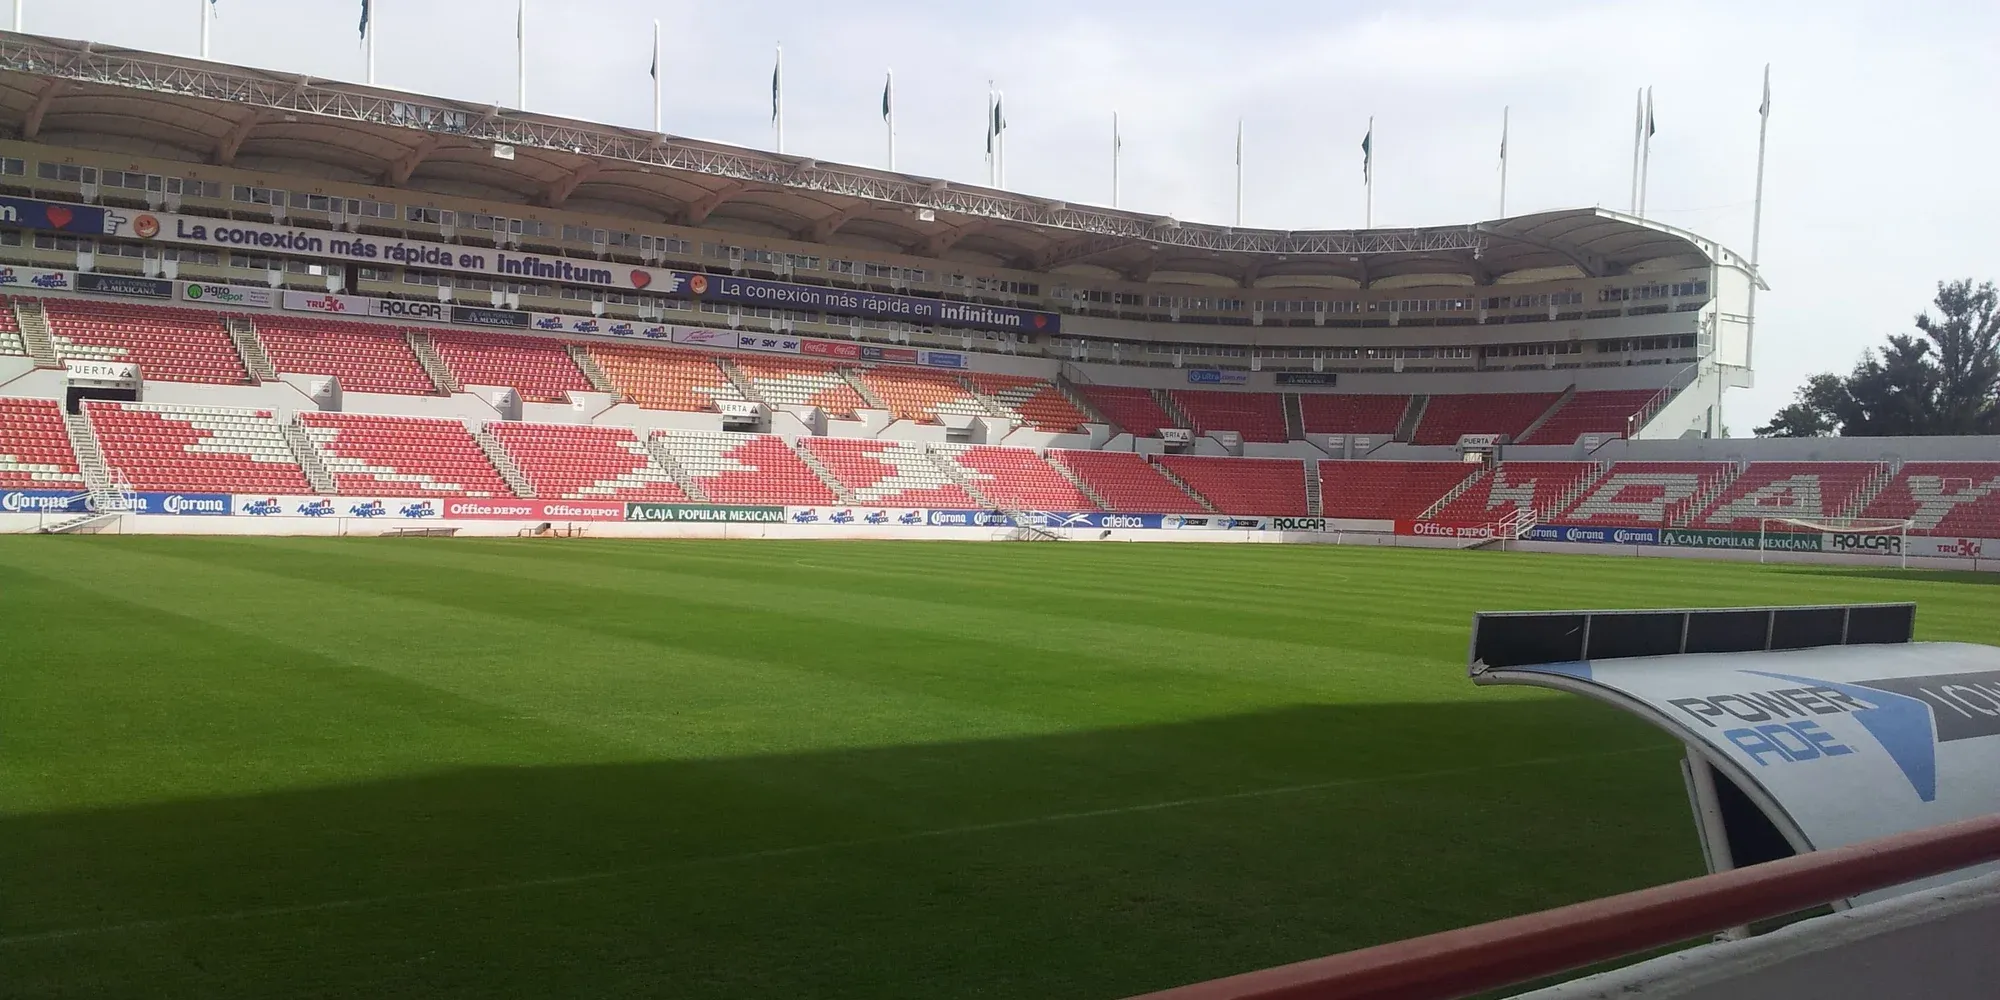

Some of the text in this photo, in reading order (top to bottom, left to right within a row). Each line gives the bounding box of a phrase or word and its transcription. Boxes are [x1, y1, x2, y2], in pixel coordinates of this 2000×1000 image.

[177, 219, 613, 285] La conexión más rápida en infinitum
[110, 285, 156, 295] MEXICANA
[204, 284, 230, 297] agro
[217, 292, 244, 302] depot
[720, 278, 1021, 326] La conexión más rápida en infinitum
[380, 300, 441, 320] ROLCAR
[479, 316, 514, 326] MEXICANA
[740, 336, 798, 350] SKY SKY SKY
[67, 364, 114, 376] PUERTA
[3, 492, 69, 513] Corona
[163, 494, 224, 515] Corona
[254, 499, 268, 507] SAN
[451, 503, 619, 517] Office DEPOT Office DEPOT
[242, 504, 282, 517] MARCOS
[297, 504, 335, 517] MARCOS
[349, 505, 386, 518] MARCOS
[399, 506, 435, 519] MARCOS
[645, 508, 784, 522] CAJA POPULAR MEXICANA
[931, 511, 967, 526] Corona
[974, 511, 1008, 526] Corona
[1274, 517, 1326, 532] ROLCAR
[1413, 523, 1496, 538] Office DEPOT
[1566, 527, 1605, 542] Corona
[1614, 527, 1653, 543] Corona
[1678, 534, 1819, 550] CAJA POPULAR MEXICANA
[1833, 533, 1902, 553] ROLCAR
[1667, 686, 1872, 728] POWER
[1919, 681, 2000, 719] IO
[1724, 719, 1853, 767] ADE
